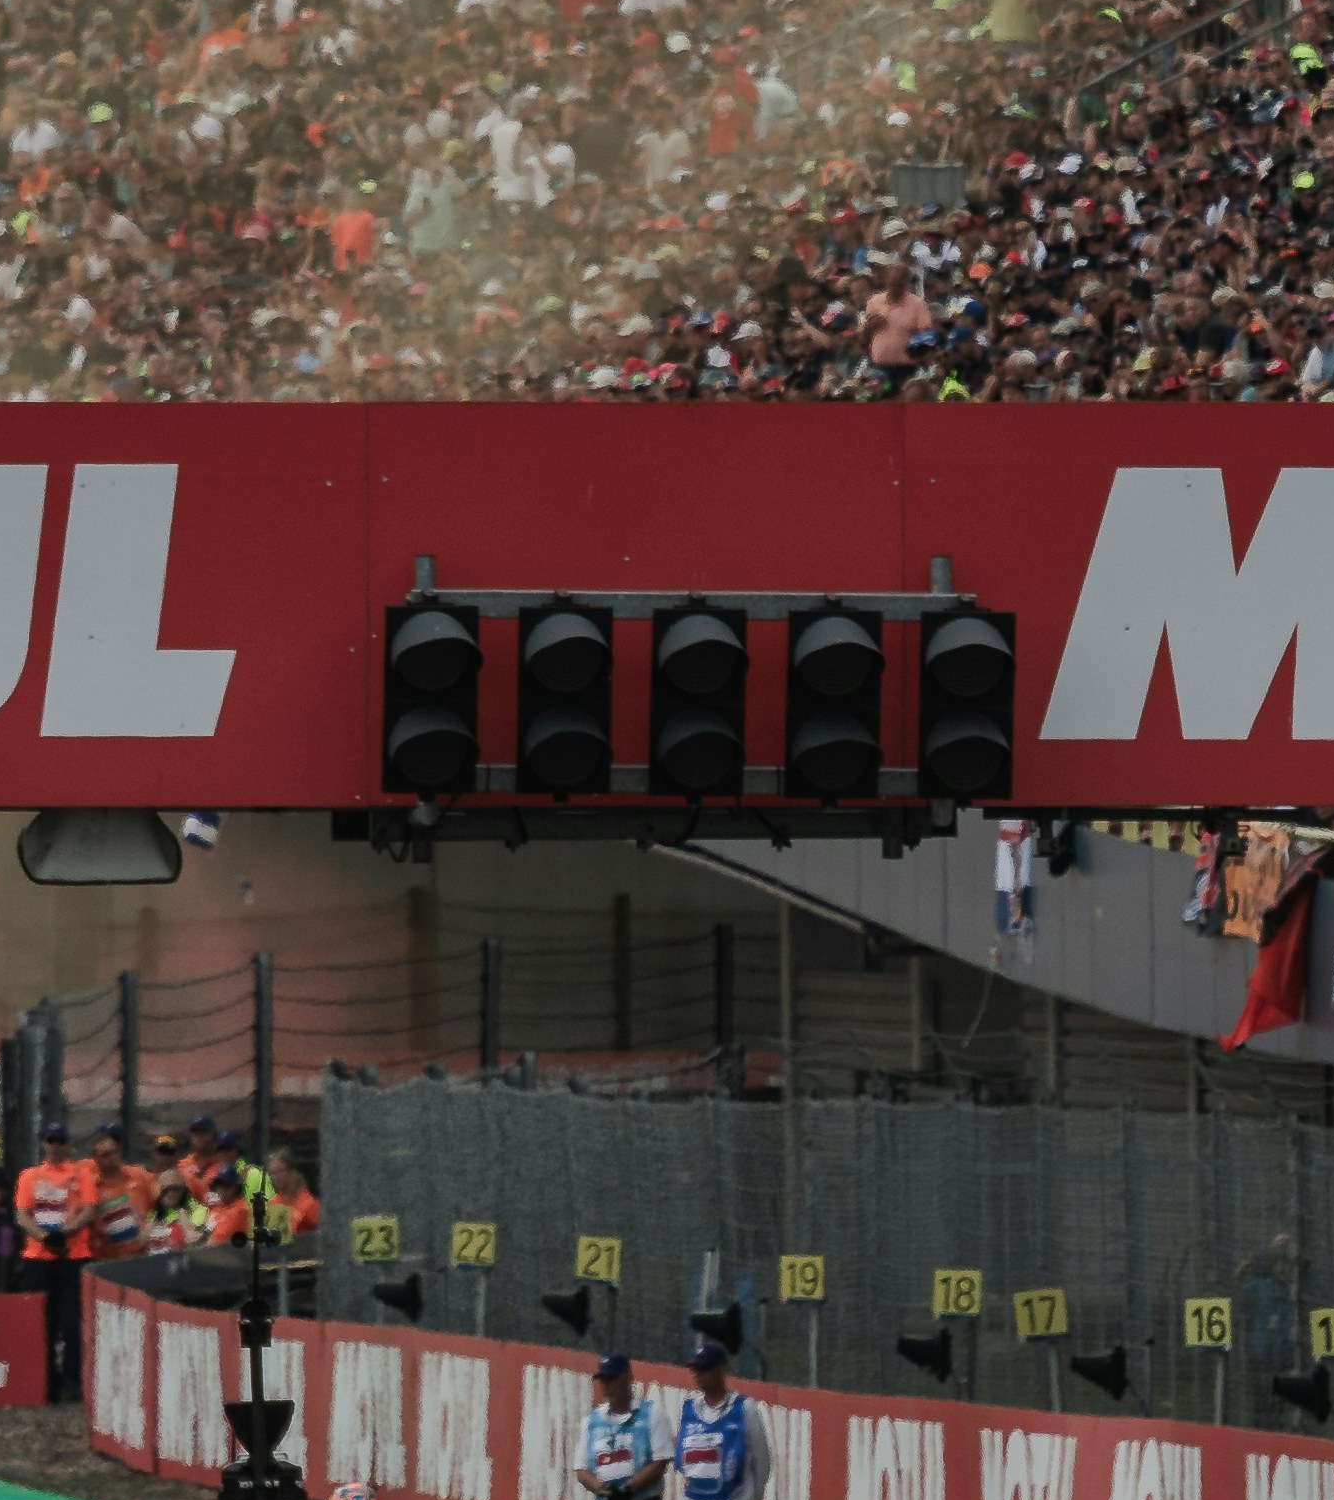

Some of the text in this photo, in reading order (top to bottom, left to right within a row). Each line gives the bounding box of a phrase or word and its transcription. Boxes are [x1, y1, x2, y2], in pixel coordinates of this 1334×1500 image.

[356, 1223, 395, 1257] 23
[456, 1227, 490, 1261] 22
[582, 1242, 615, 1278] 21
[788, 1261, 819, 1295] 19
[939, 1275, 976, 1312] 18
[1021, 1296, 1058, 1333] 17
[1192, 1305, 1227, 1342] 16
